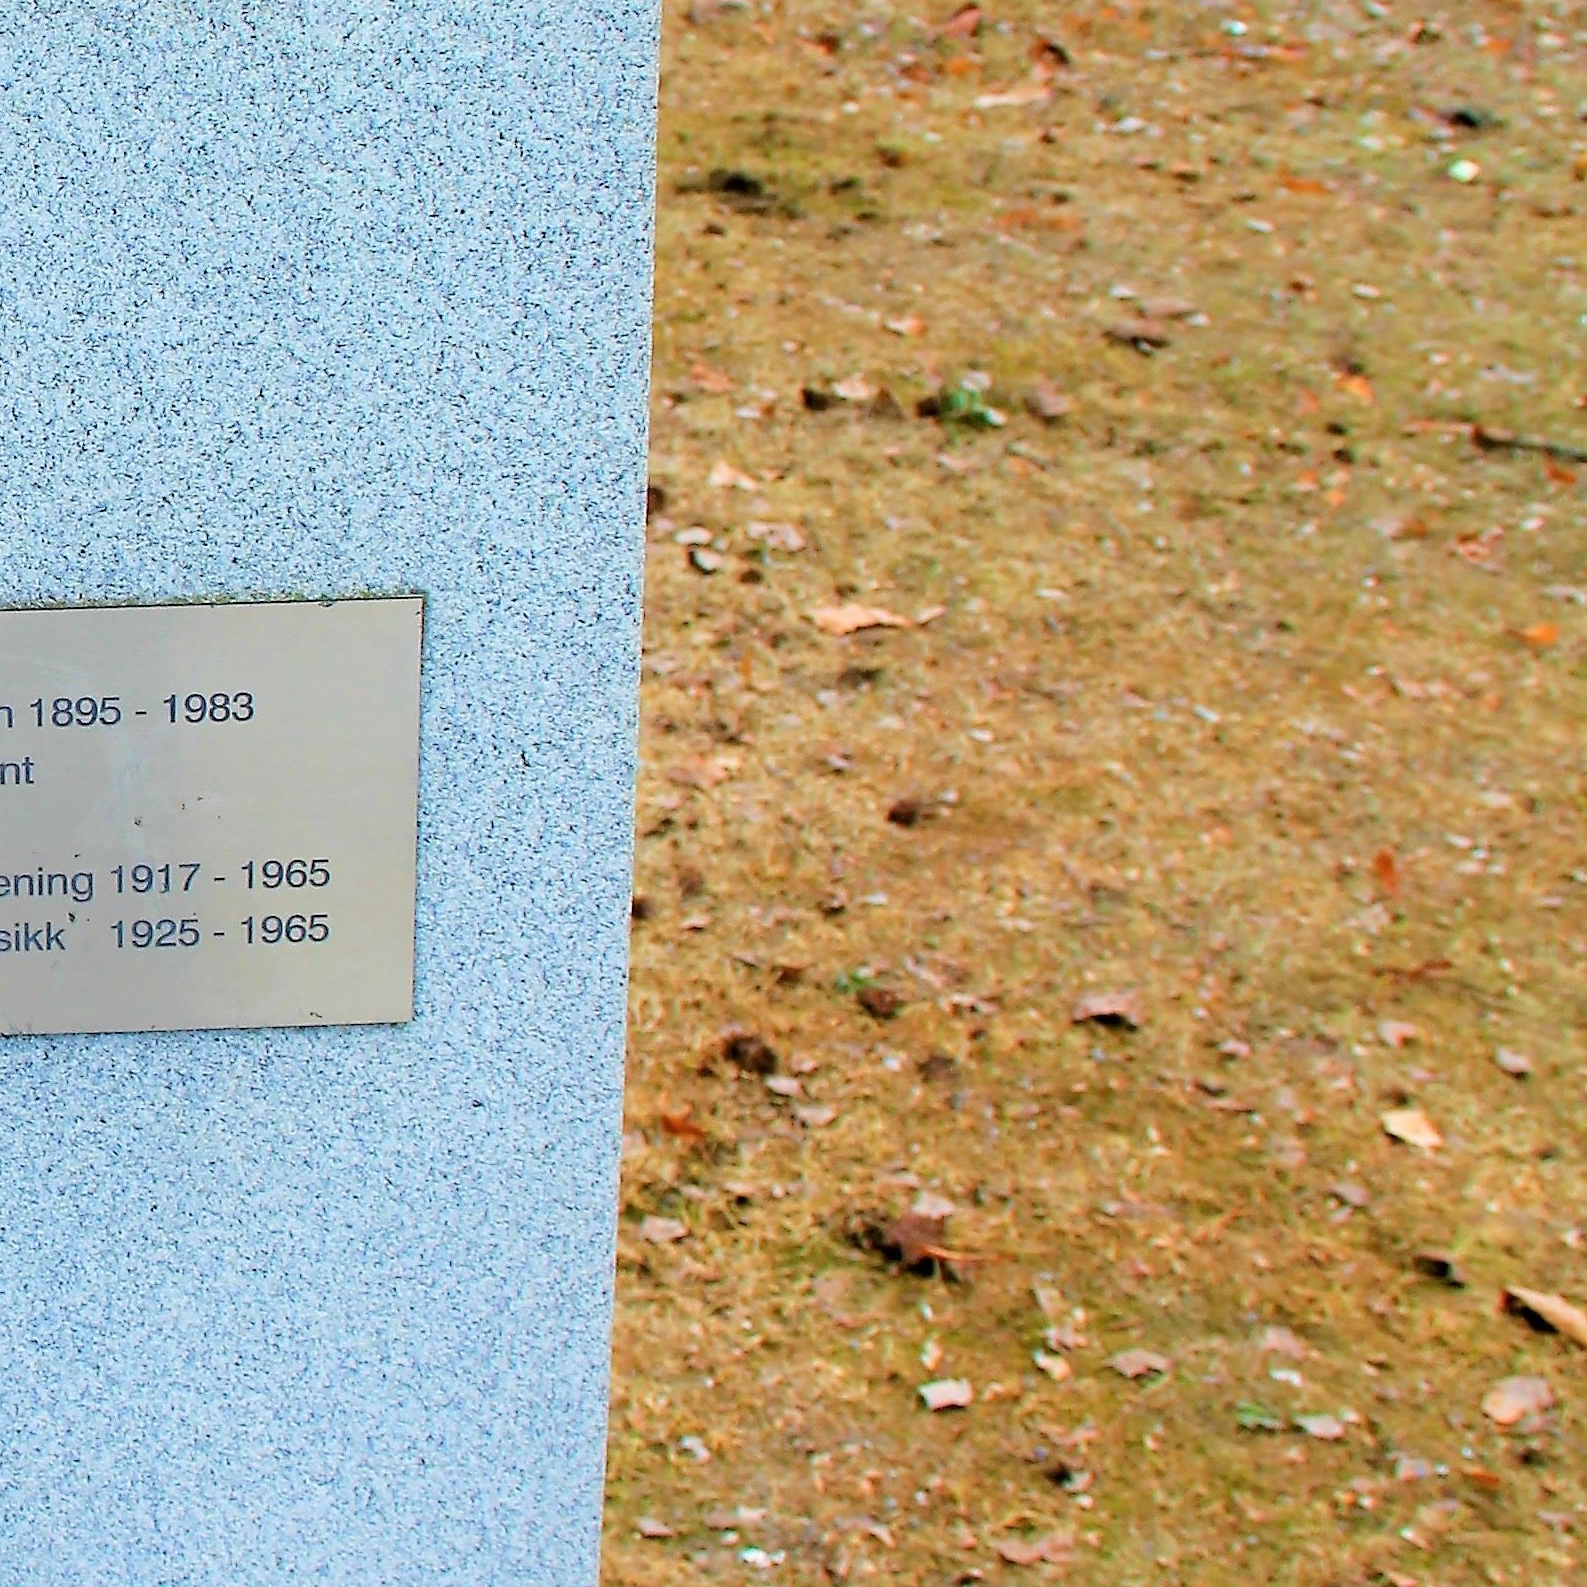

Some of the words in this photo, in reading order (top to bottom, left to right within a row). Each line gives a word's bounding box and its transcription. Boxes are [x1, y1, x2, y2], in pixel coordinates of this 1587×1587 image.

[29, 696, 122, 728] 1895
[163, 691, 255, 724] 1983
[110, 863, 202, 894] 1917
[240, 858, 331, 890] 1965
[110, 918, 201, 949] 1925
[240, 913, 330, 945] 1965
